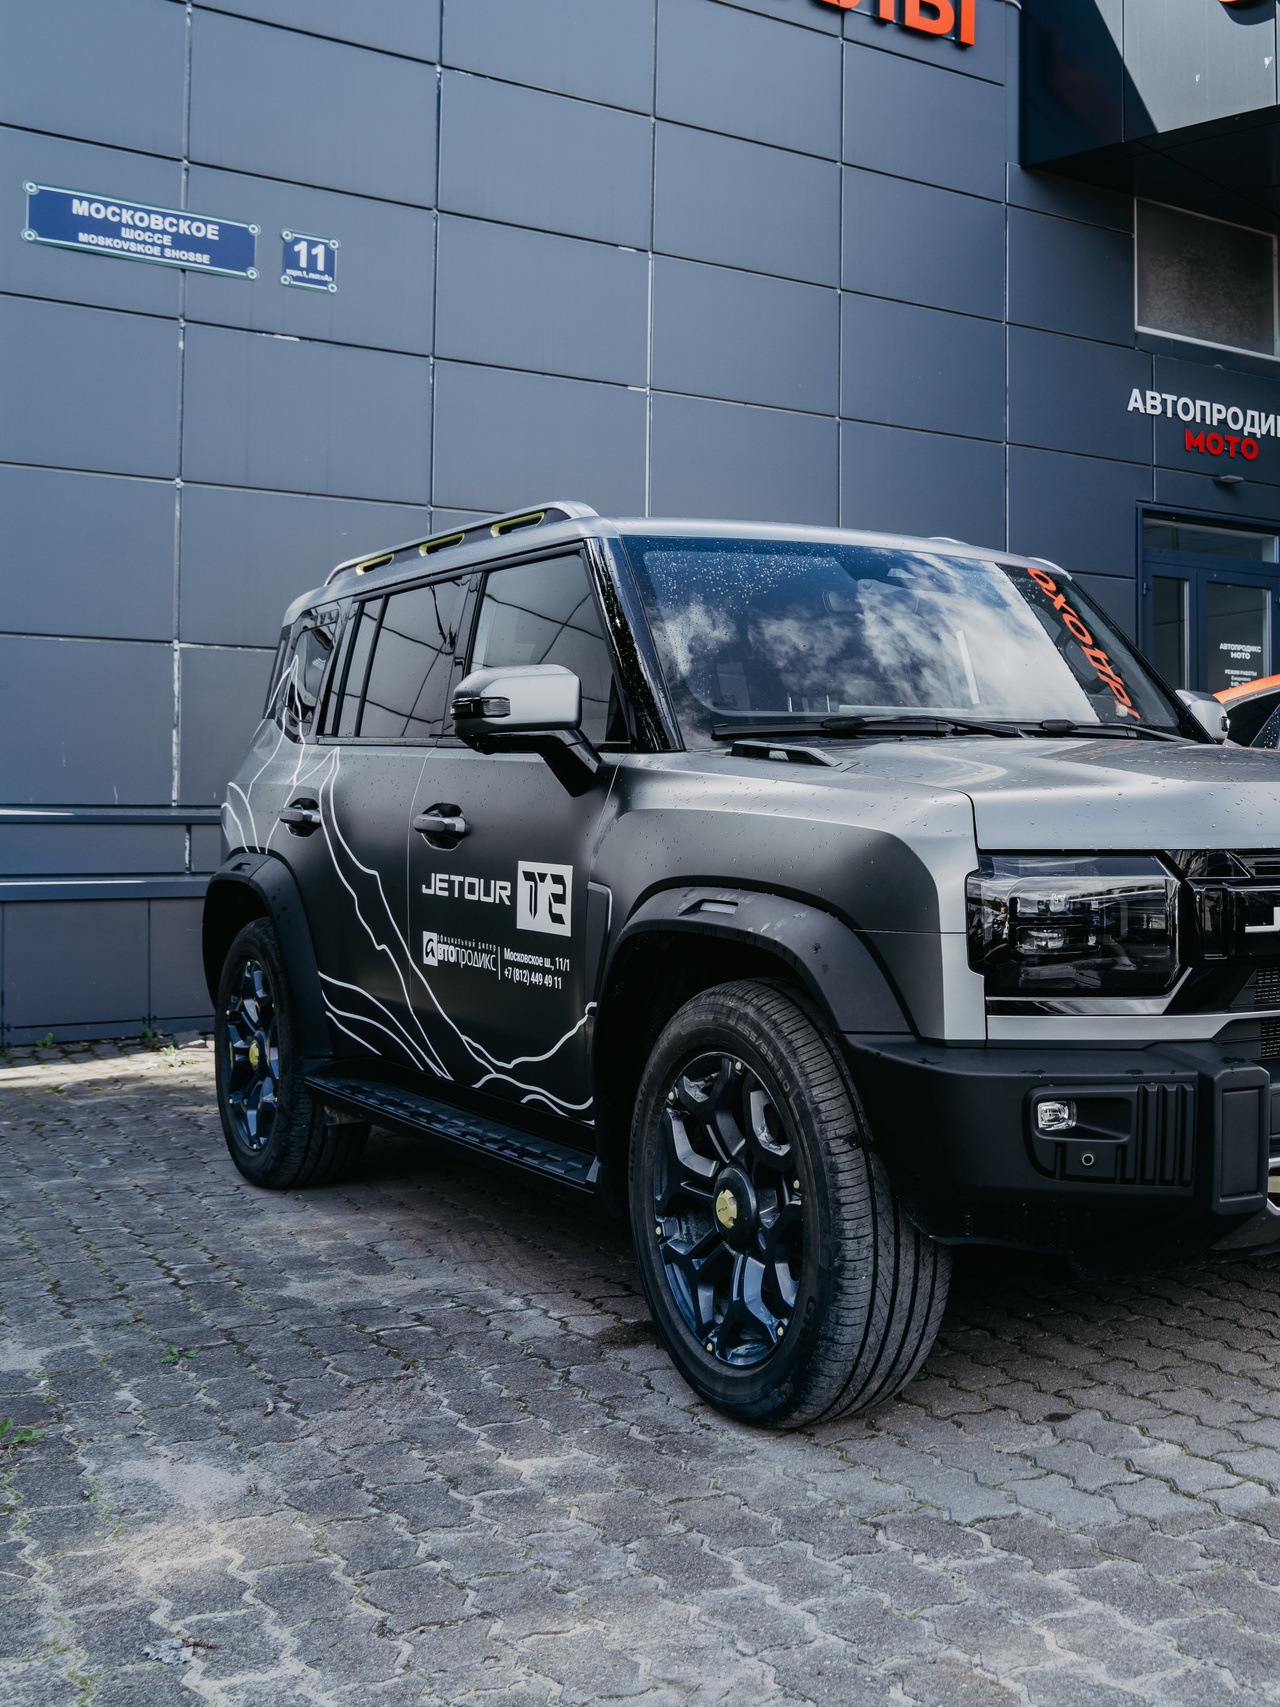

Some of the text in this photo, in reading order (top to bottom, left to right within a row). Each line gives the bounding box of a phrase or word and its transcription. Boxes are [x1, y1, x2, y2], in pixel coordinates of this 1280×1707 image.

[72, 199, 220, 241] МОСКОВСКОЕ
[78, 232, 211, 265] MOSKOVSKOE SHOSSE
[121, 227, 173, 246] ШОССЕ
[293, 240, 325, 272] 11
[1185, 428, 1259, 461] МОТО
[1219, 642, 1262, 653] АВТОПРОДИКС
[1230, 652, 1251, 660] МОТО
[421, 872, 511, 906] JETOUR
[504, 947, 544, 966] Московское
[555, 957, 570, 971] 11/1
[504, 967, 562, 990] +7 (812) 449 49 11
